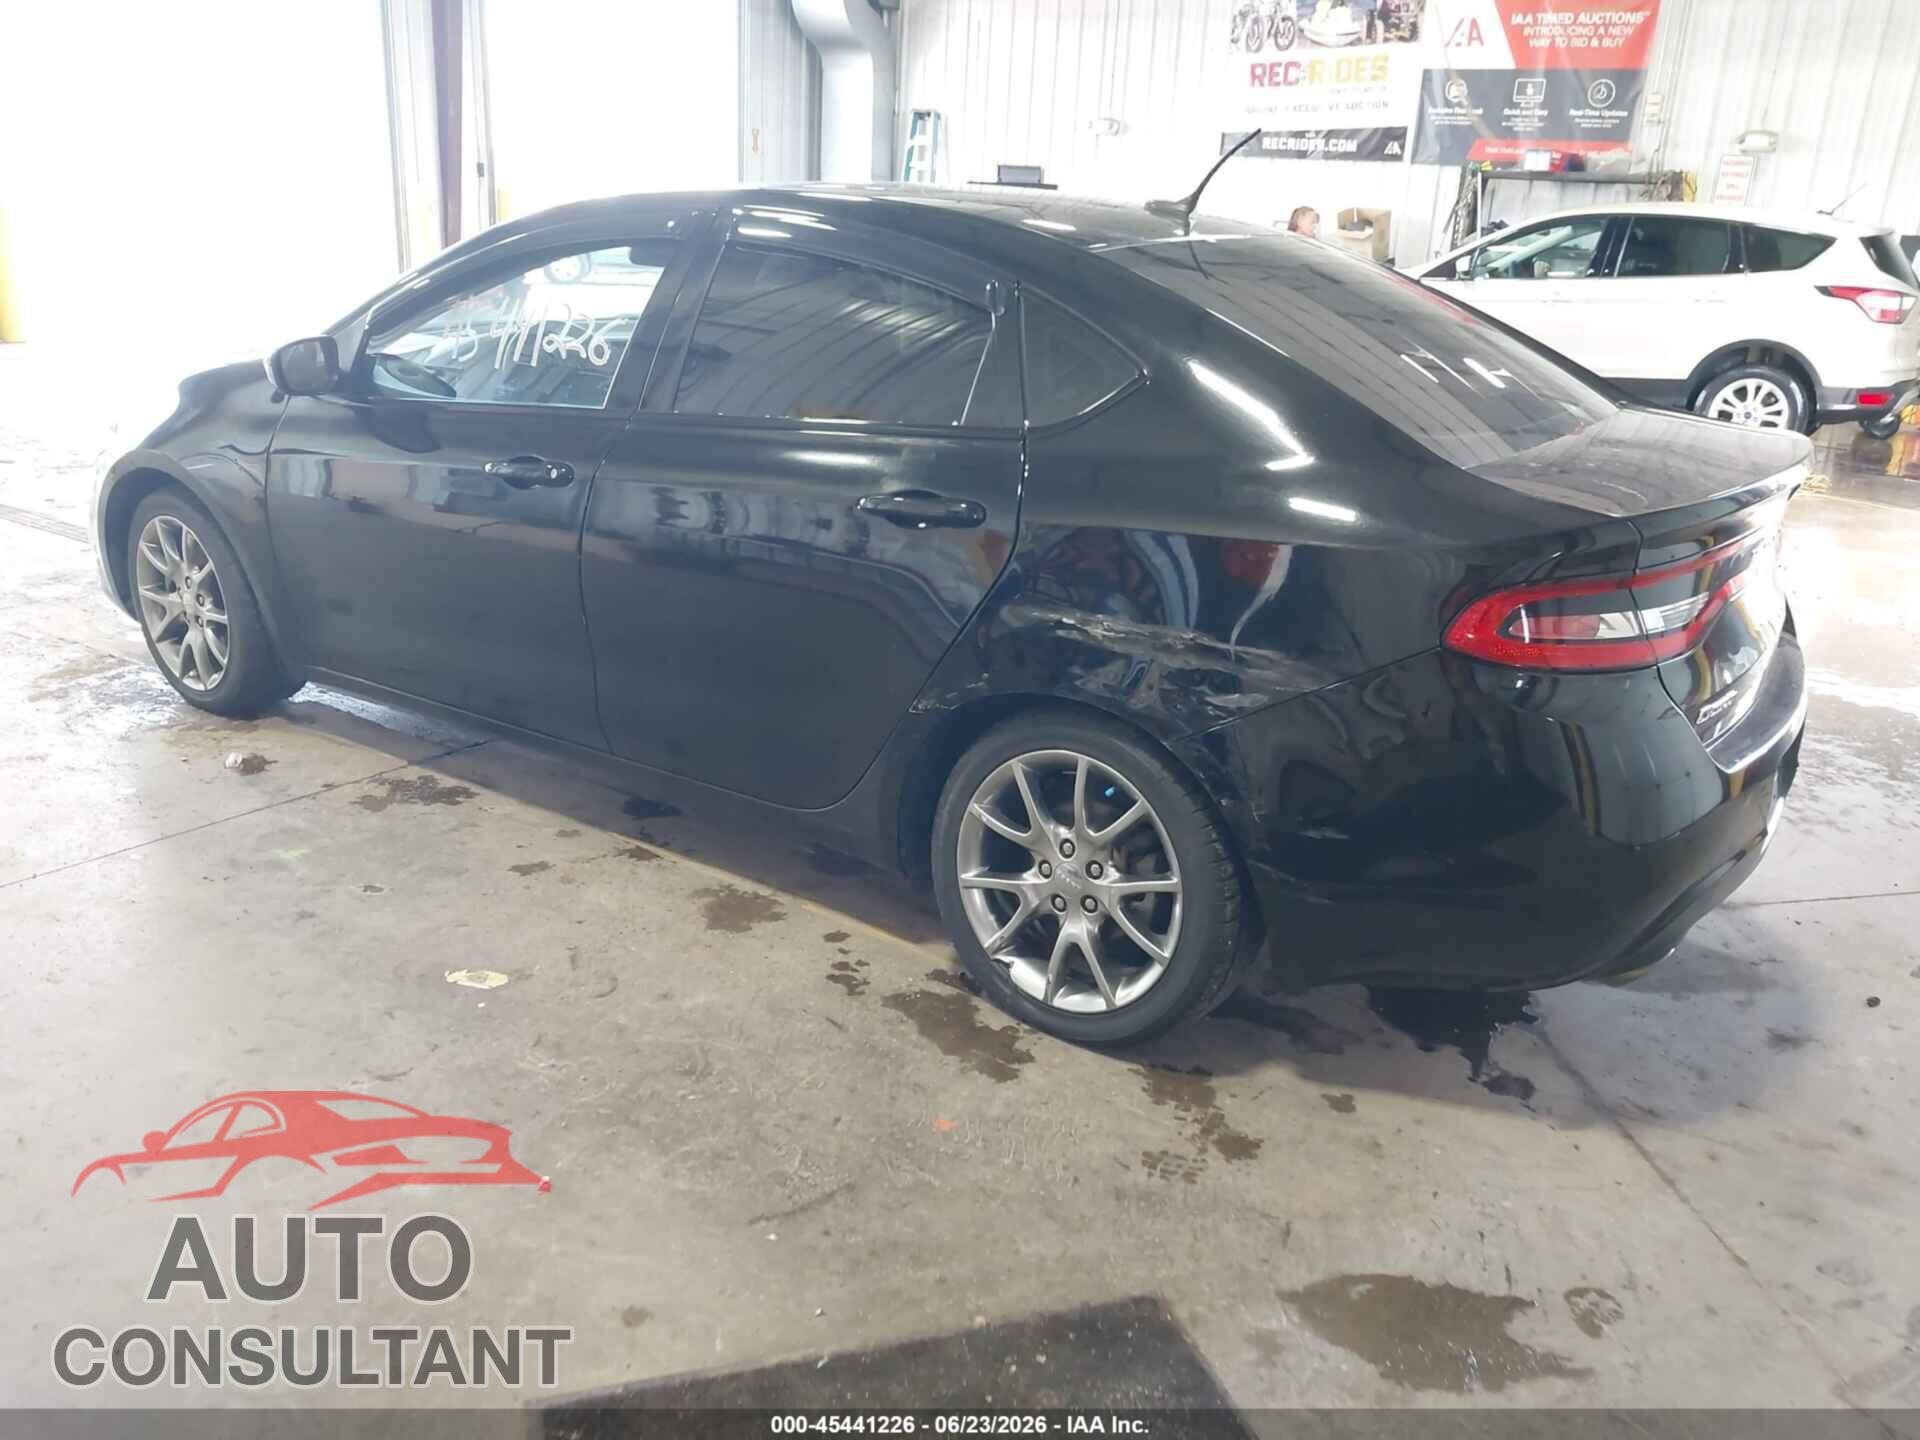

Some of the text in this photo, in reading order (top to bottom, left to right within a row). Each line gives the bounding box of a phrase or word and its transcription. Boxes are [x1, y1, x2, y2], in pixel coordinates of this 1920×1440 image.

[1523, 25, 1635, 37] INTRODUCING A NEW
[1528, 37, 1554, 48] WAY
[1554, 37, 1569, 48] TO
[1601, 37, 1626, 48] BUY
[1262, 136, 1358, 153] RECRID.COM
